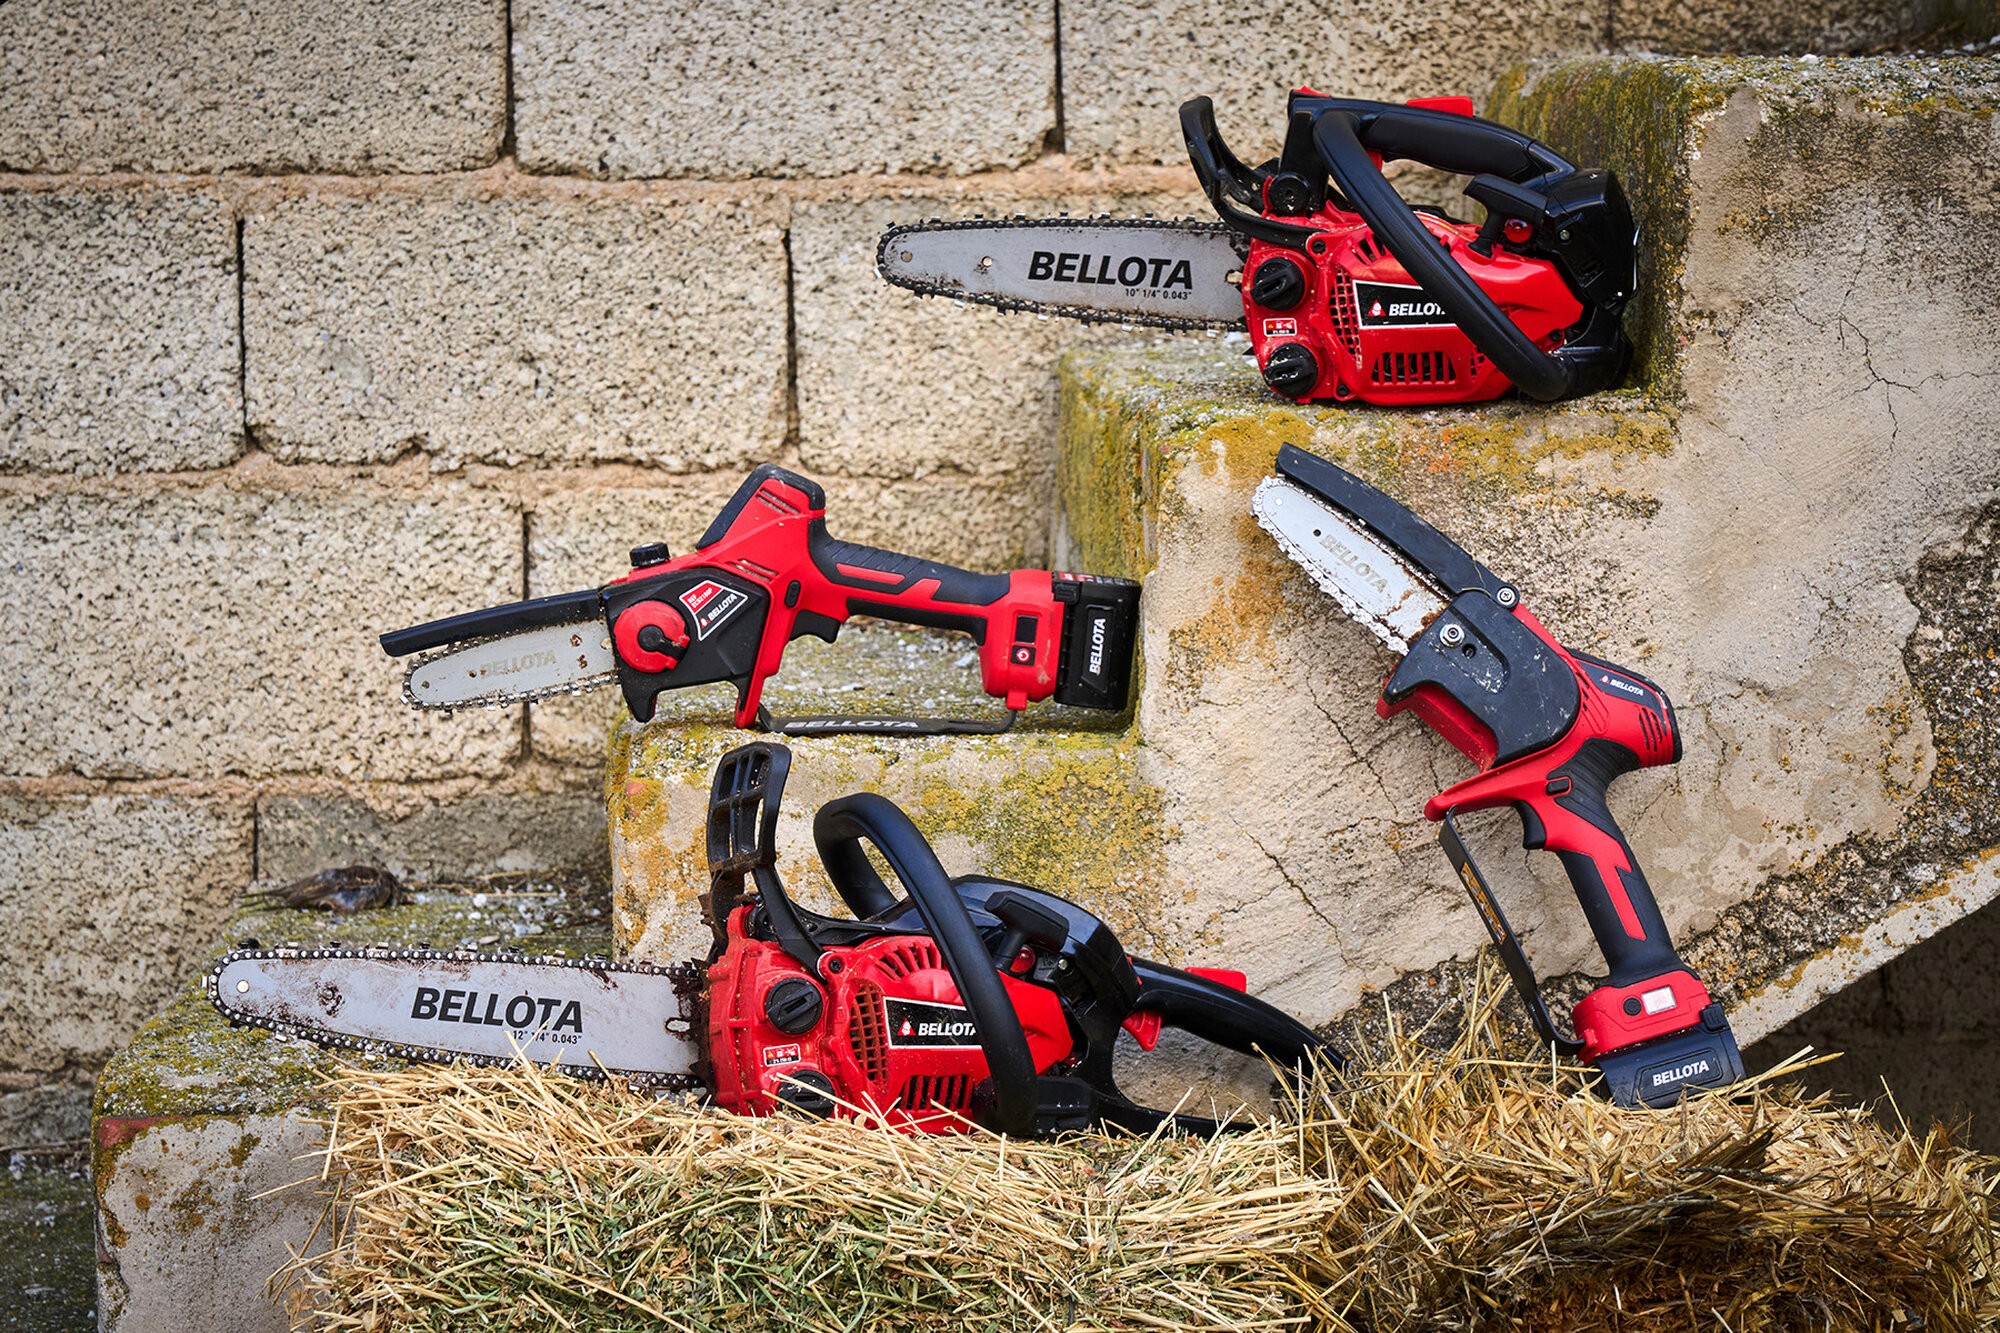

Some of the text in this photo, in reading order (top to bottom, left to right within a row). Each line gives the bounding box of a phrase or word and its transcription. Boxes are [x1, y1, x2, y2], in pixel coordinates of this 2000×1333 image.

[1028, 251, 1193, 290] BELLOTA
[1125, 288, 1192, 300] 10" 1/4" 0.043"
[1320, 534, 1388, 593] BELLOTA
[707, 593, 738, 621] BELLOTA
[1089, 618, 1106, 676] BELLOTA
[1609, 679, 1644, 696] BELLOTA
[785, 720, 919, 729] BELLOTA
[411, 987, 583, 1033] BELLOTA
[513, 1030, 528, 1040] 12"
[552, 1033, 582, 1045] 0.043"
[1653, 1060, 1710, 1086] BELLOTA
